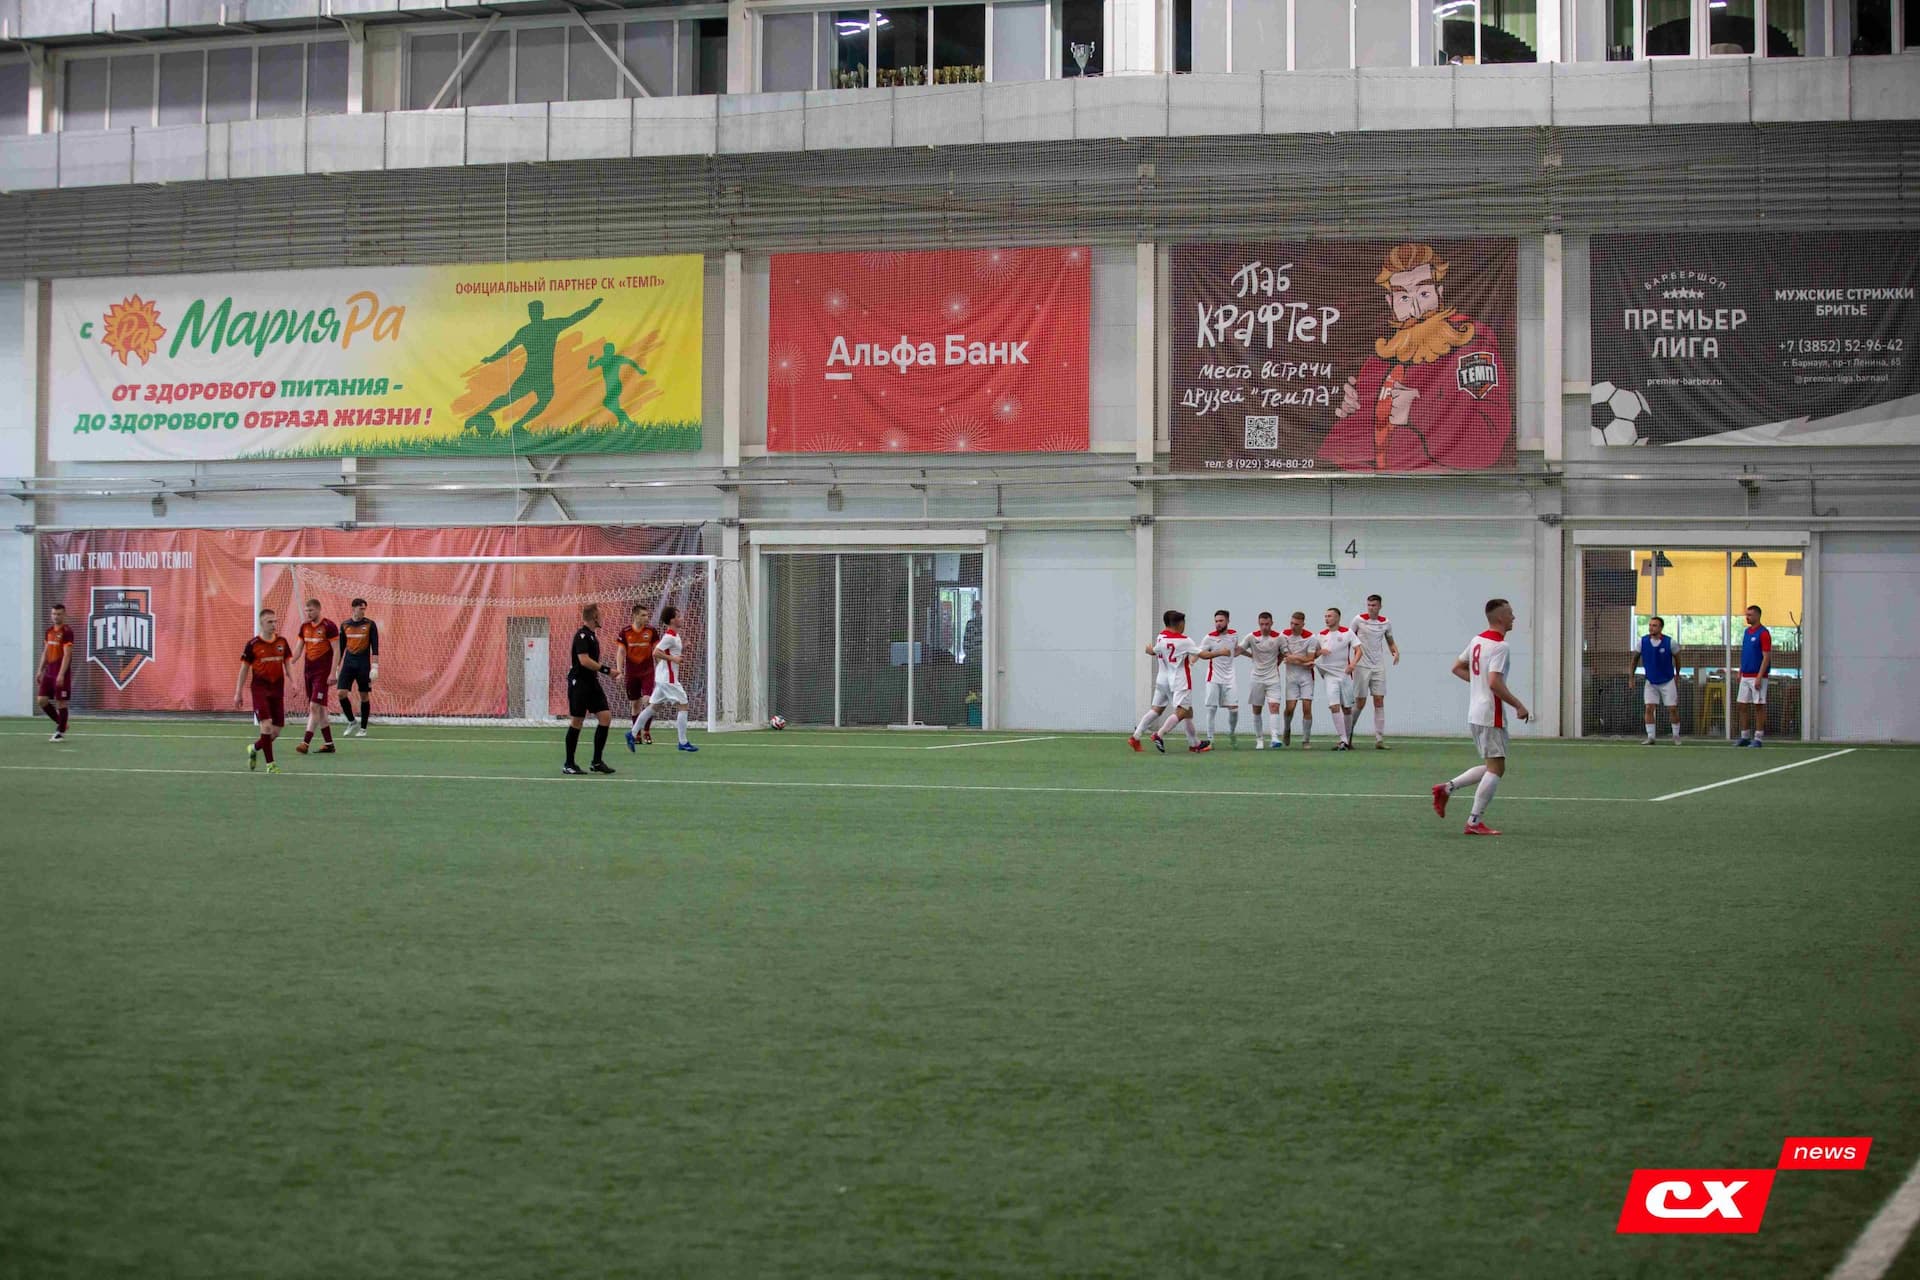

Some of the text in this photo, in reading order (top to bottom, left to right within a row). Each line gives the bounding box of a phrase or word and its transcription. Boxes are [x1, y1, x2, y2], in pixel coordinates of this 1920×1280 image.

[456, 275, 665, 296] ОФИЦИАЛЬНЫЙ ПАРТНЕР СК «ТЕМП»
[1231, 261, 1294, 298] Паб
[1644, 271, 1727, 290] БАРБЕРШОП
[1775, 288, 1914, 301] МУЖСКИЕ СТРИЖКИ
[1624, 308, 1748, 330] ПРЕМЬЕР
[1816, 304, 1868, 316] БРИТЬЕ
[826, 334, 1030, 375] Альфа Банк
[1652, 337, 1719, 358] ЛИГА
[1779, 338, 1904, 353] +7 (3852) 52-96-42
[1461, 365, 1495, 385] ТЕМП
[1646, 377, 1723, 387] premier-barber.ru
[111, 384, 142, 402] ОТ
[144, 381, 276, 405] ЗДОРОВОГО
[280, 378, 390, 398] ПИТАНИЯ
[73, 413, 107, 435] ДО
[108, 411, 240, 435] ЗДОРОВОГО
[243, 409, 330, 430] ОБРАЗА
[1205, 459, 1314, 470] тел: 8 (929) 346-80-20
[1345, 538, 1359, 559] 4
[54, 551, 193, 572] ТЕМП, ТЕМП, ТОЛЬКО ТЕМП!
[93, 615, 149, 651] ТЕМП
[1167, 643, 1177, 663] 2
[1472, 643, 1482, 676] 8
